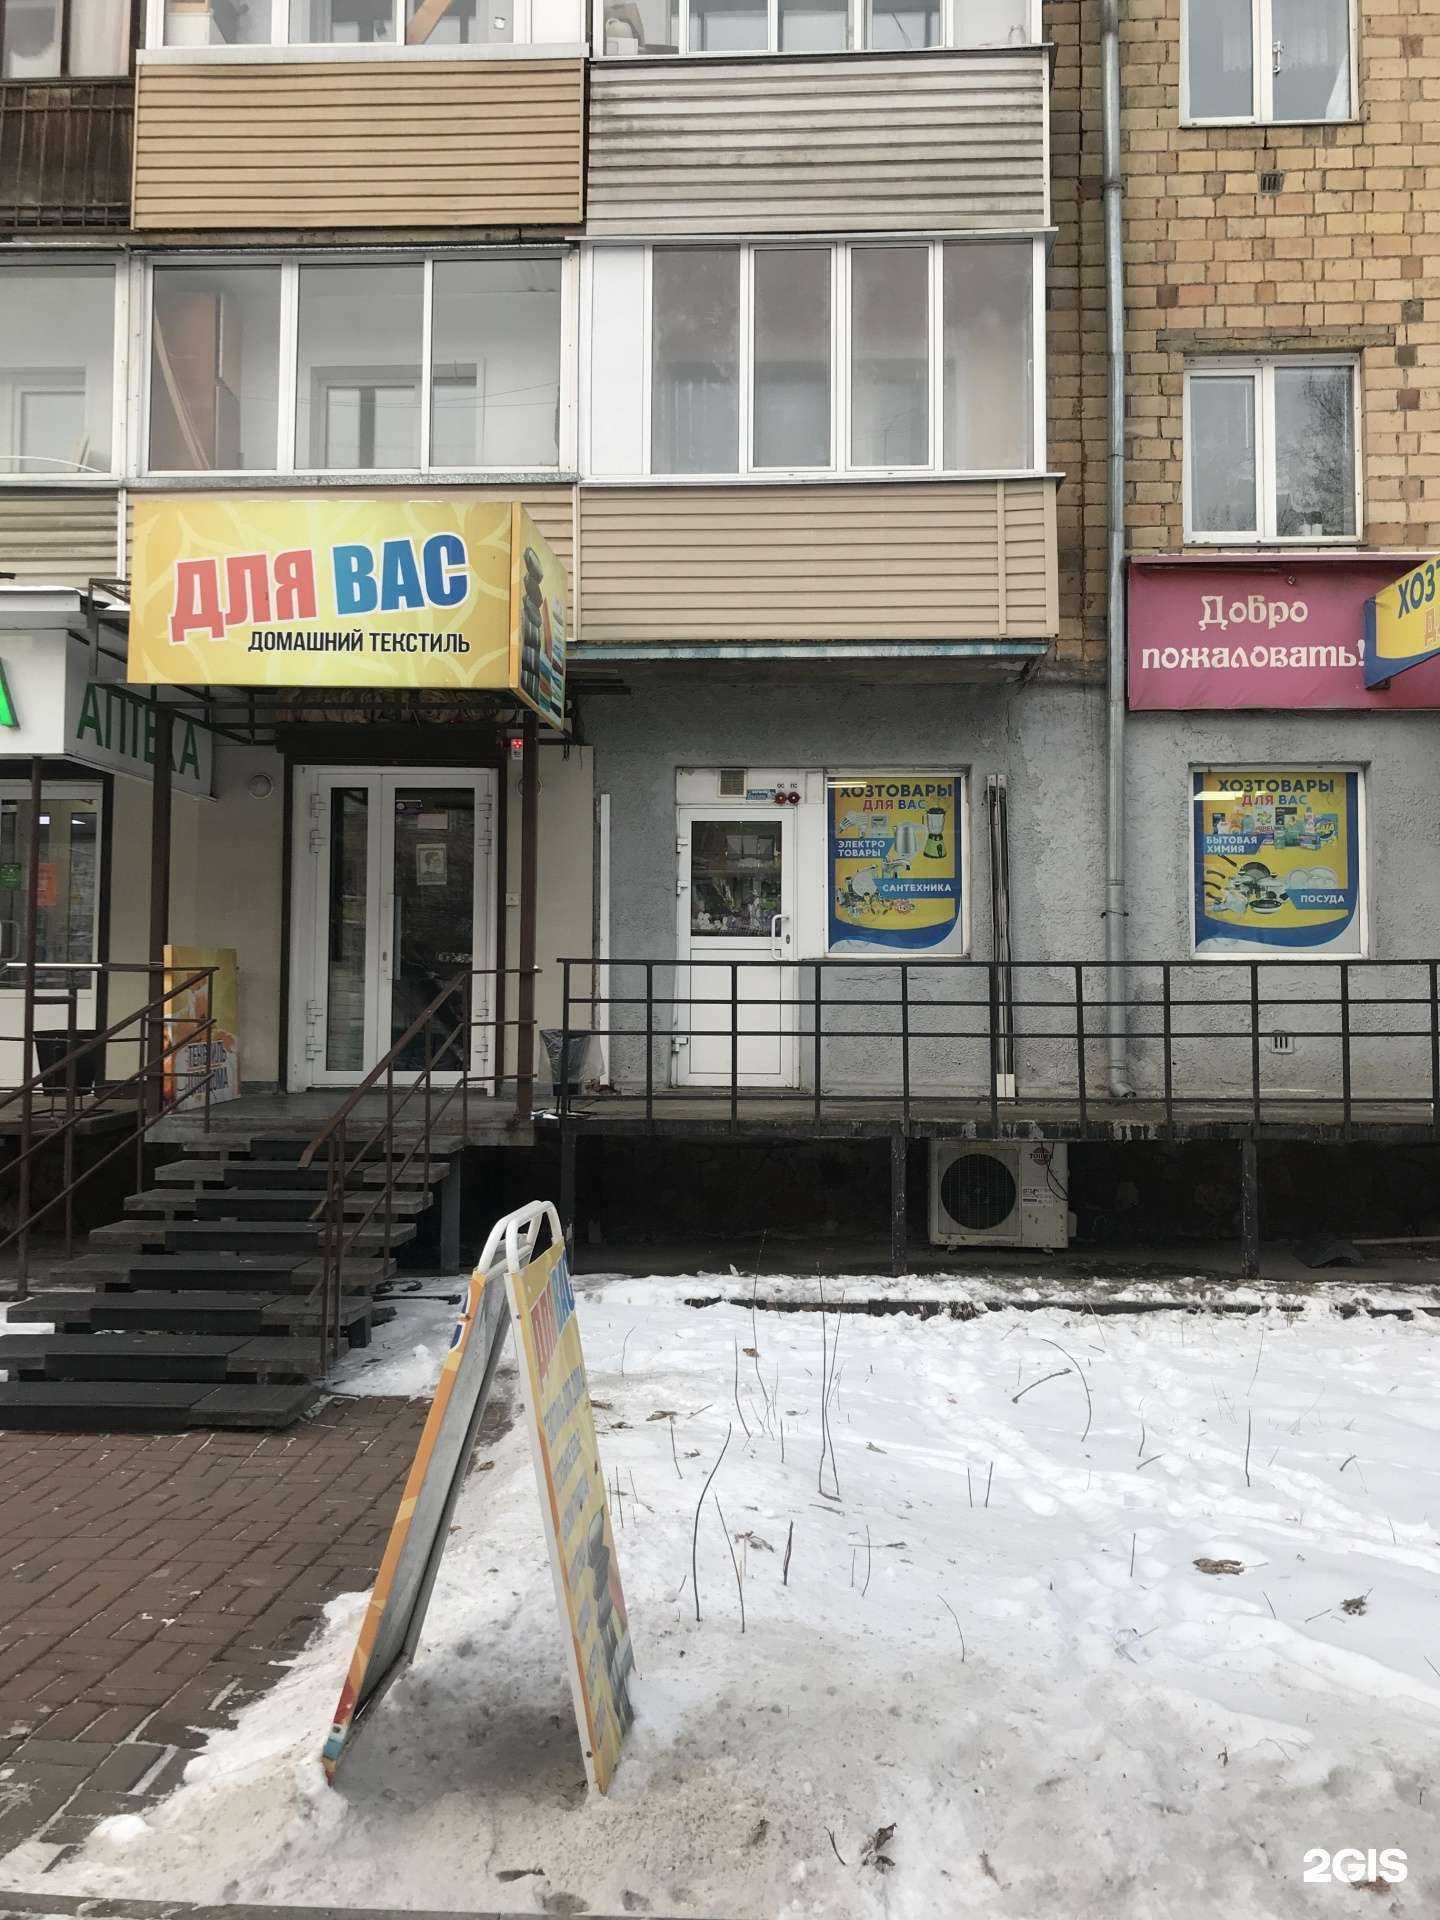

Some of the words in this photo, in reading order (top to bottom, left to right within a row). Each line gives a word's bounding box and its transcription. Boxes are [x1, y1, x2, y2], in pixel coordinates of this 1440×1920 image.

[170, 548, 318, 644] ДЛЯ
[332, 534, 468, 616] ВАС
[1397, 559, 1440, 619] ХОЗ
[1198, 595, 1308, 631] Добро
[248, 629, 363, 652] ДОМАШНИЙ
[369, 631, 471, 653] ТЕКСТИЛЬ
[1142, 639, 1366, 669] пожаловать!
[77, 682, 200, 780] АПТЕА
[839, 783, 954, 798] ХОЗТОВАРЫ
[1218, 779, 1334, 793] ХОЗТОВАРЫ
[863, 799, 895, 812] ДЛЯ
[898, 799, 926, 810] ВАС
[1241, 794, 1274, 807] ДЛЯ
[1278, 794, 1308, 805] ВАС
[838, 840, 886, 849] ЭЛЕКТРО
[1206, 835, 1258, 845] БЫТОВАЯ
[838, 849, 881, 857] ТОВАРЫ
[1206, 845, 1245, 854] ХИМИЯ
[882, 883, 952, 893] САНТЕХНИКА
[1300, 894, 1345, 904] ПОСУДА
